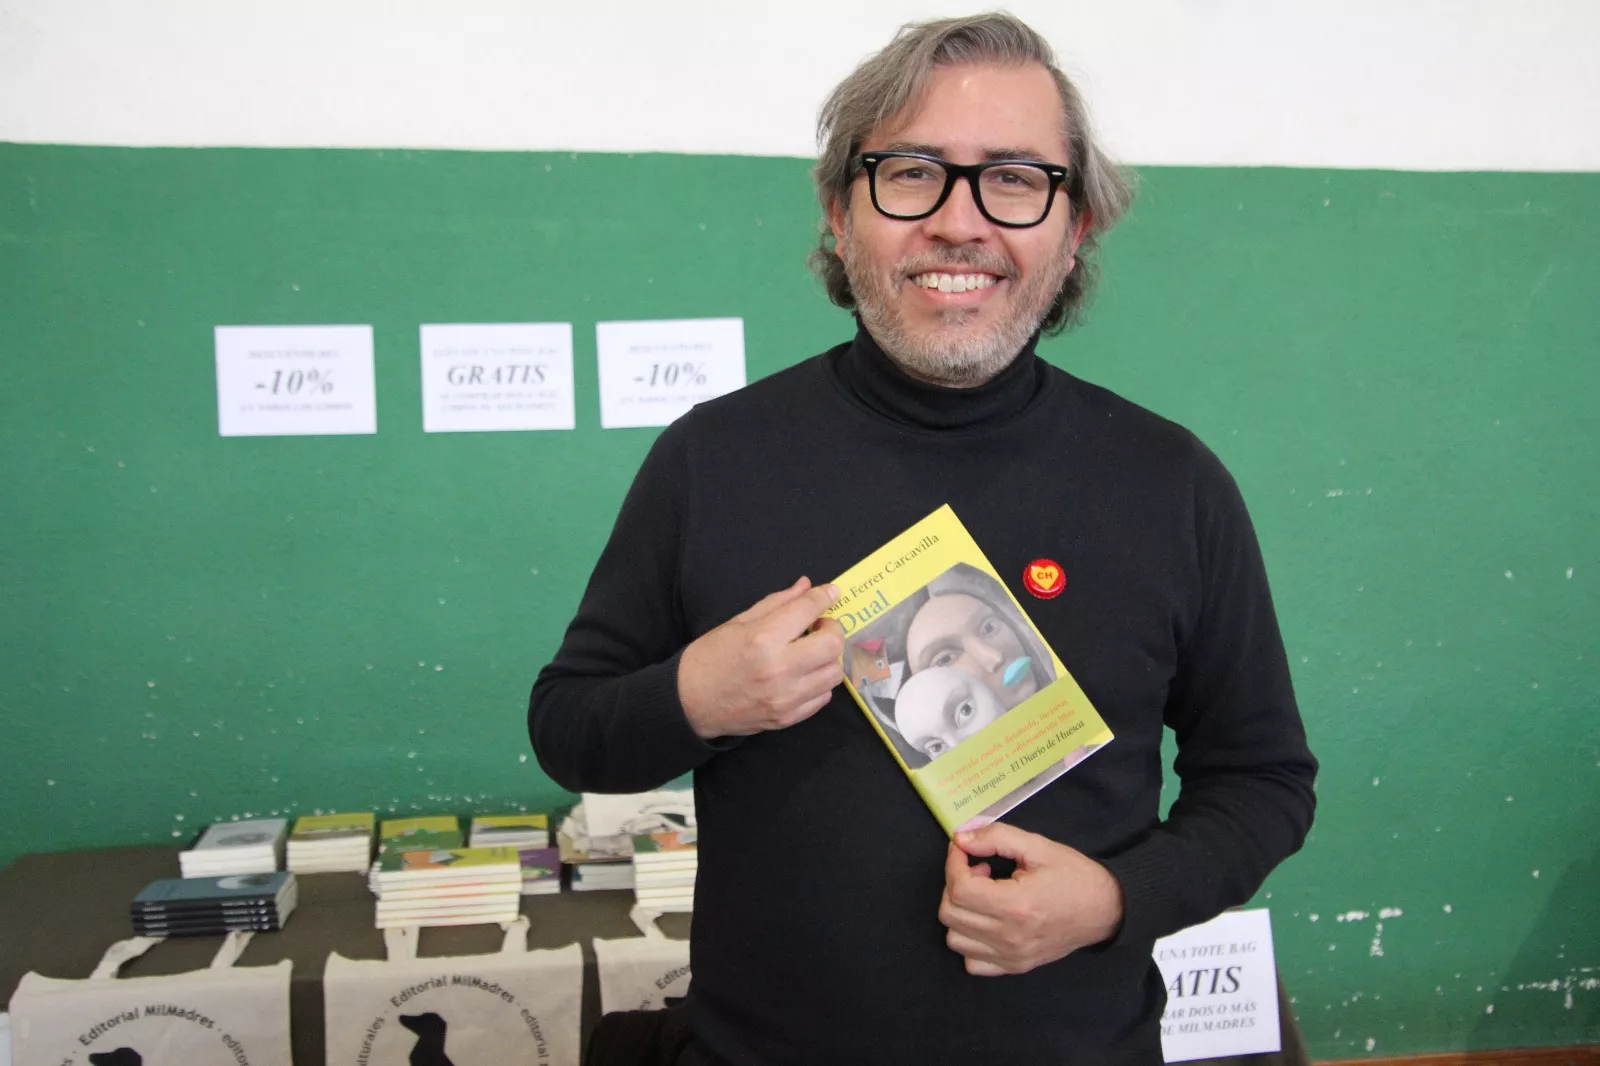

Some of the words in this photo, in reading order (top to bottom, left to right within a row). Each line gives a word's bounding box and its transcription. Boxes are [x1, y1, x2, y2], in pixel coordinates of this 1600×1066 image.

[254, 366, 334, 396] -10%
[445, 362, 549, 386] GRATIS
[632, 360, 707, 388] -10%
[850, 571, 884, 598] Ferrer
[885, 534, 940, 574] Carcavilla
[1037, 572, 1053, 580] CH
[836, 590, 890, 634] Dual
[953, 794, 973, 811] Juan
[972, 772, 1006, 798] Marqués
[1010, 762, 1021, 773] El
[1020, 747, 1046, 766] Diario
[1046, 739, 1056, 750] de
[1056, 720, 1085, 742] Huesca
[1159, 947, 1187, 960] UNA
[1191, 944, 1225, 957] TOTE
[1230, 941, 1257, 954] BAG
[1168, 966, 1244, 998] ATIS
[78, 1007, 140, 1046] Editorial
[144, 1004, 216, 1029] MilMadres
[390, 976, 448, 1008] Editorial
[451, 975, 516, 1004] MilMadres
[520, 1008, 550, 1058] editorial
[1189, 1005, 1213, 1018] DOS
[1217, 1003, 1228, 1014] O
[1178, 1018, 1256, 1034] MILMADRES
